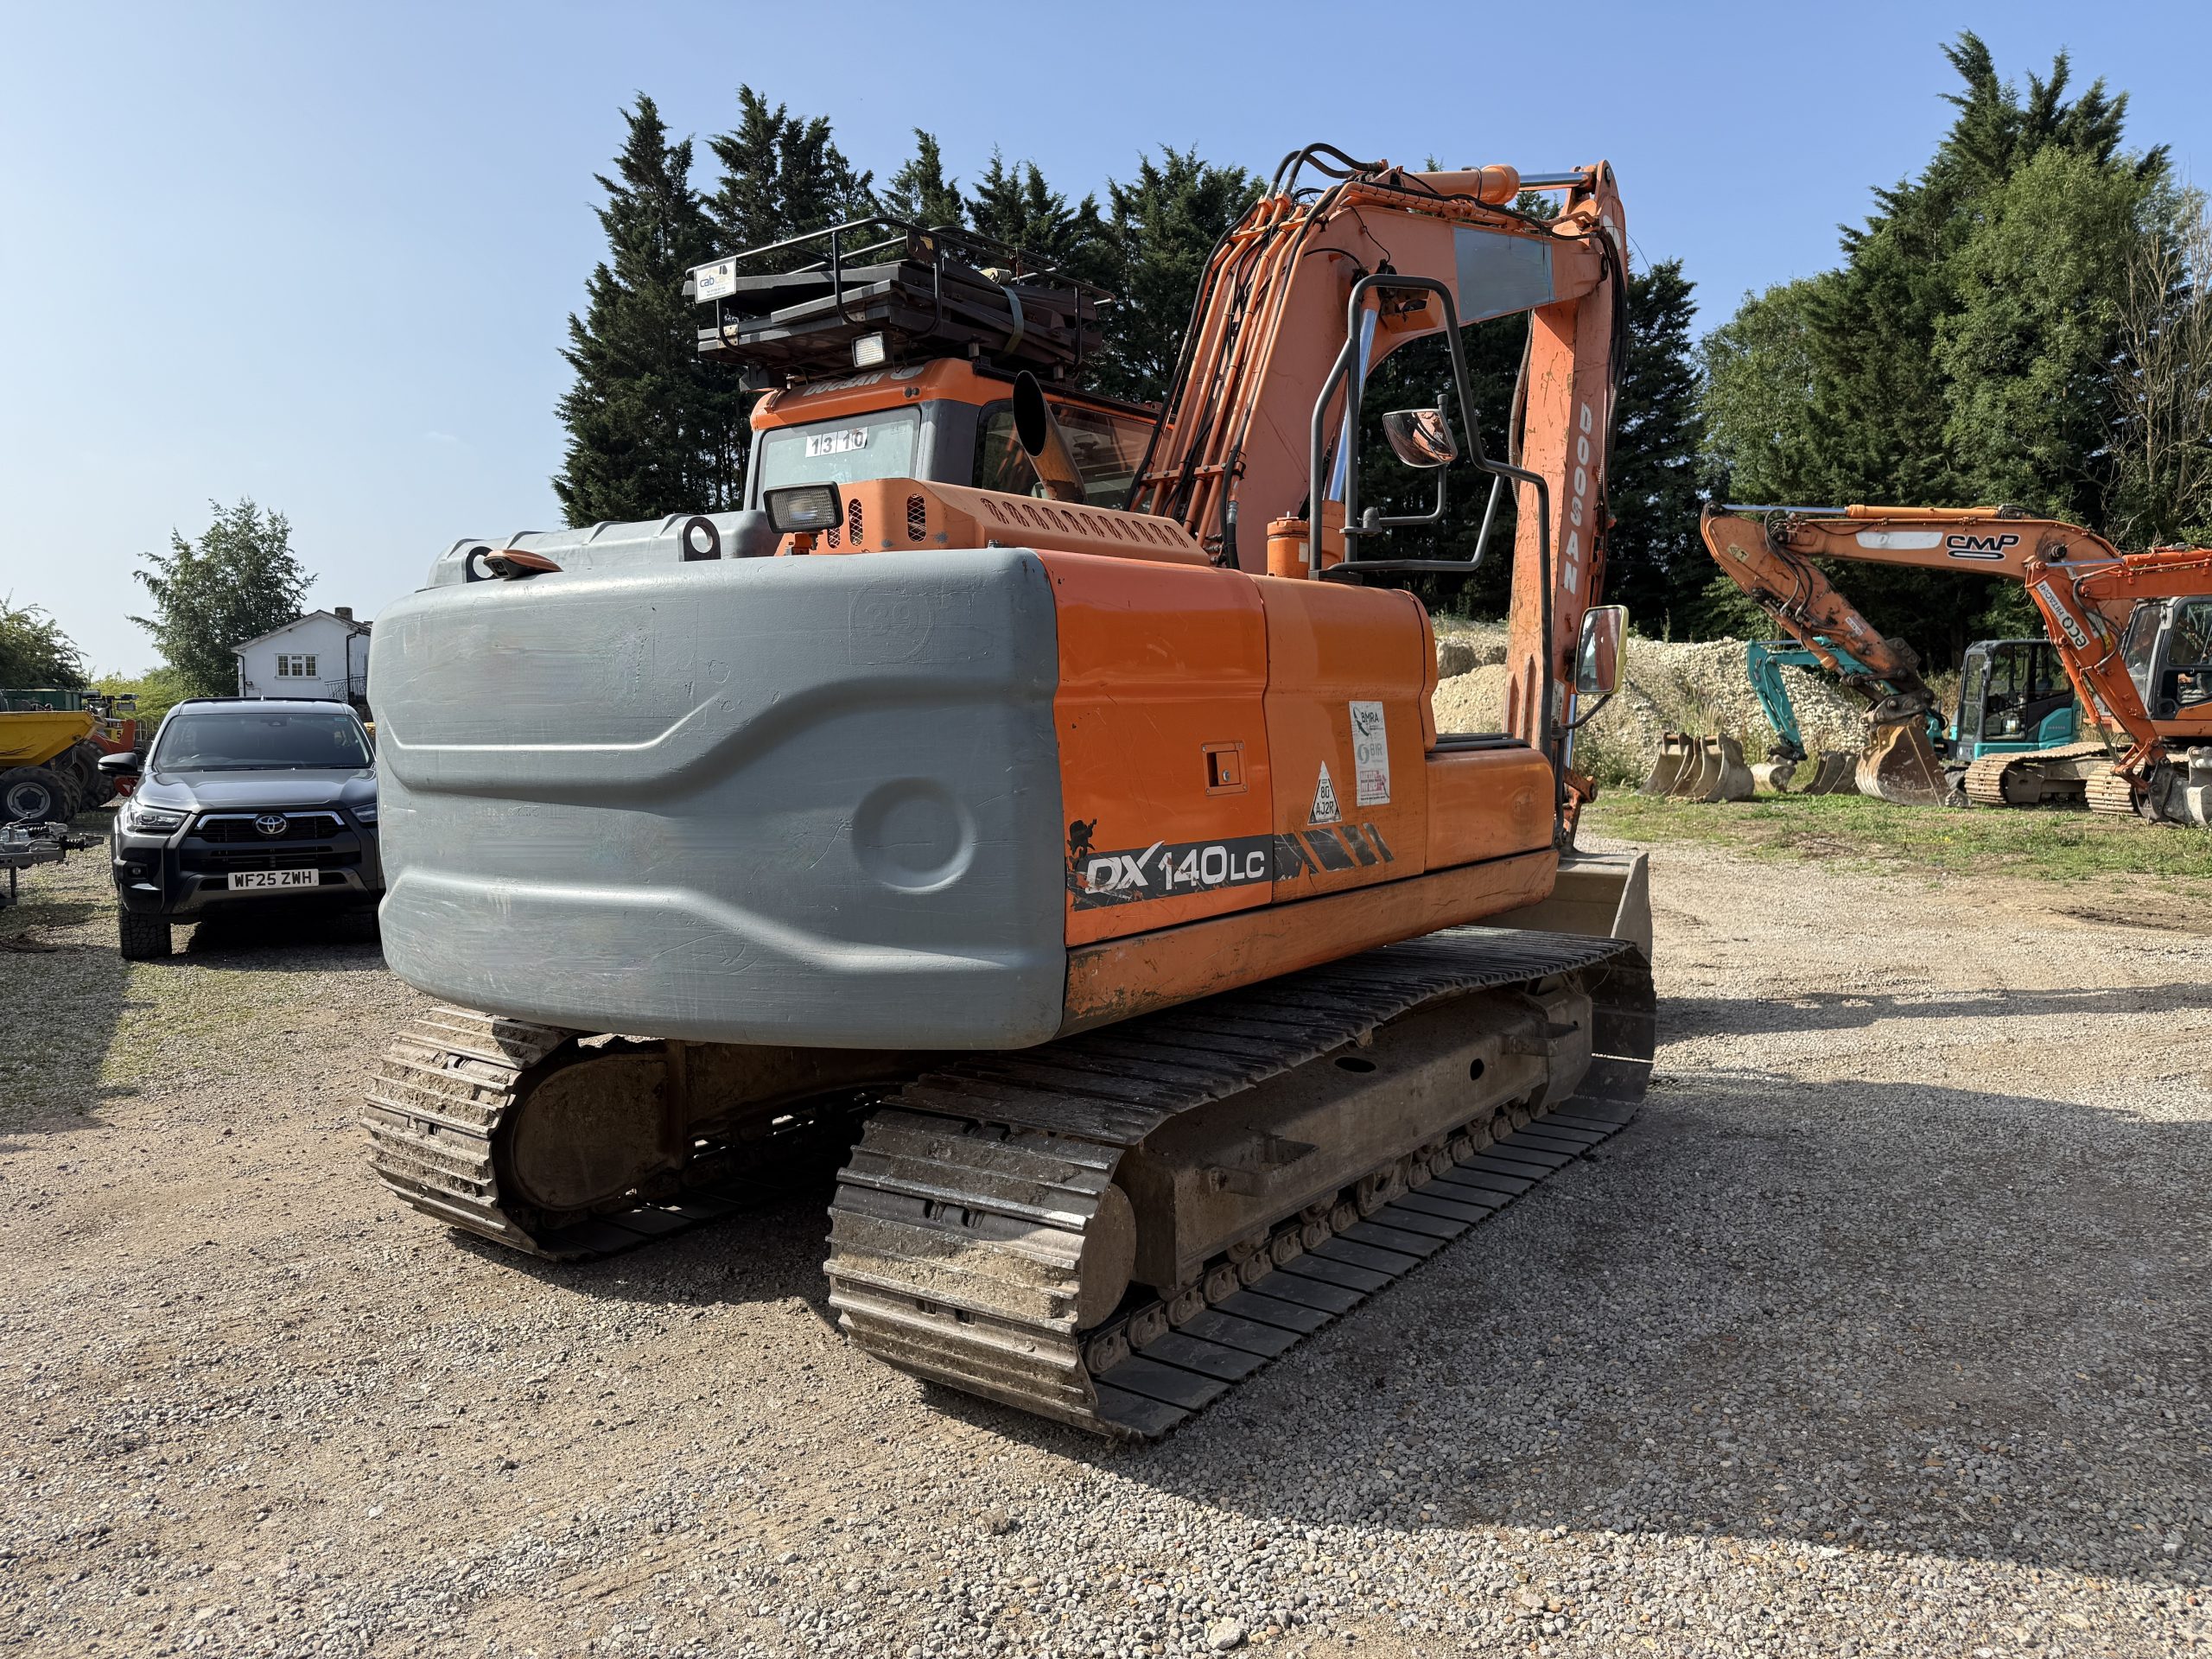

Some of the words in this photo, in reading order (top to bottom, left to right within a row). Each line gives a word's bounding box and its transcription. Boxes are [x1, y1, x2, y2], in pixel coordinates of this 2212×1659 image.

[803, 372, 885, 397] DOOSAN
[1563, 402, 1592, 594] DOOSAN
[1946, 533, 2020, 552] CMP
[2039, 583, 2065, 617] HITACHI
[1361, 712, 1380, 723] BMRA
[1370, 743, 1382, 757] BIR
[1316, 801, 1334, 816] AJ2R
[234, 873, 276, 887] WF25
[281, 871, 312, 885] ZWH
